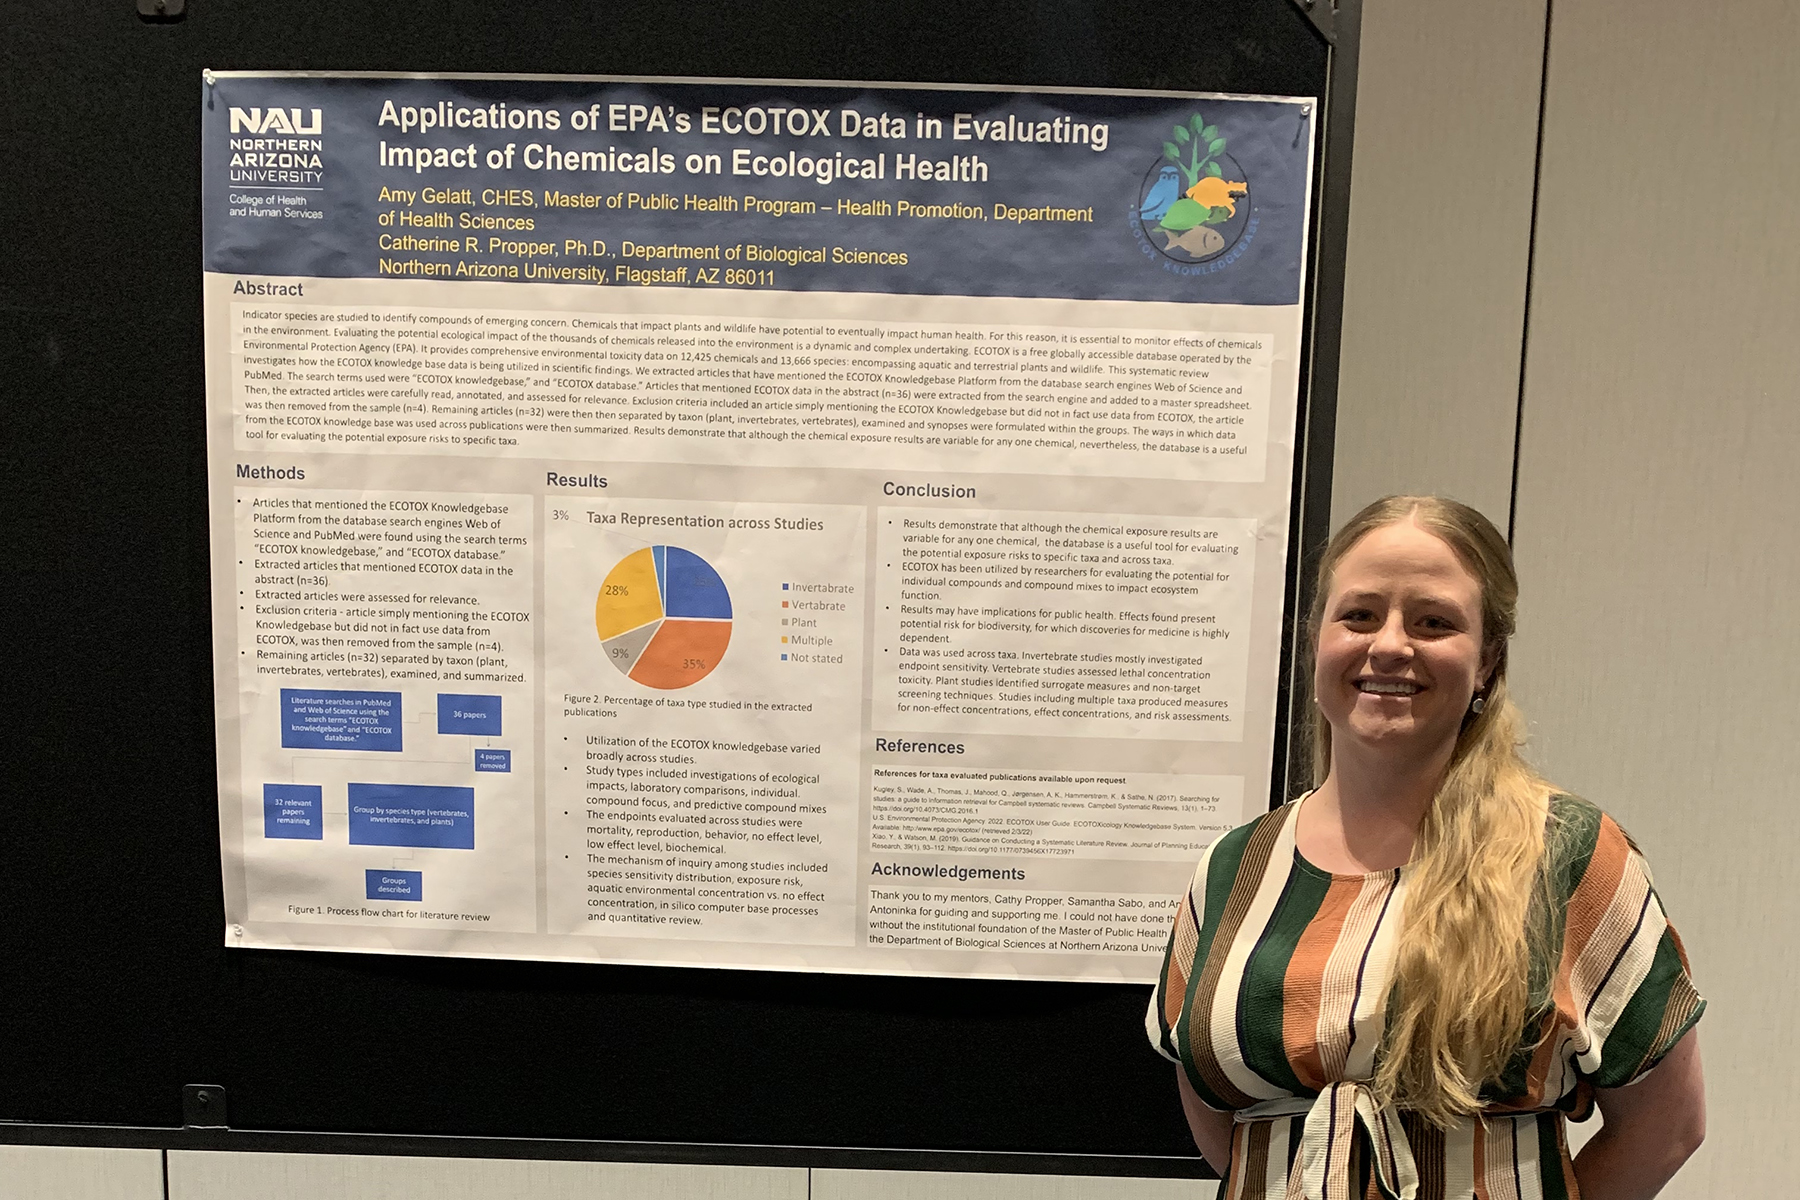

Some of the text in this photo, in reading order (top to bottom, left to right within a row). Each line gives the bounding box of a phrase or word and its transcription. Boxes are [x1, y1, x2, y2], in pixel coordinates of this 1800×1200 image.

[228, 106, 322, 135] NAU
[378, 99, 1108, 151] Applications of EPA's ECOTOX Data in Evaluating
[229, 138, 322, 151] NORTHERN
[229, 152, 322, 168] ARIZONA
[380, 140, 988, 183] Impact of Chemicals on Ecological Health
[230, 169, 322, 183] UNIVERSITY
[229, 193, 306, 208] College of Health
[378, 186, 416, 206] Amy
[421, 187, 475, 207] Gelatt,
[481, 188, 538, 208] CHES,
[544, 190, 602, 208] Master
[606, 192, 623, 208] of
[628, 192, 678, 210] Public
[684, 193, 738, 211] Health
[744, 195, 815, 217] Program
[837, 198, 891, 216] Health
[897, 200, 987, 222] Promotion,
[994, 203, 1093, 224] Department
[229, 206, 323, 219] and Human Services
[378, 209, 534, 230] of Health Sciences
[379, 233, 908, 266] Catherine R. Propper, Ph.D., Department of Biological Sciences
[1128, 210, 1260, 276] ECOTOX KNOWLEDGEBASE
[379, 258, 774, 286] Northern Arizona University, Flagstaff, AZ 86011
[233, 279, 303, 296] Abstract
[246, 430, 263, 439] tool
[266, 430, 278, 440] for
[280, 431, 326, 442] evaluating
[328, 431, 342, 441] the
[345, 432, 384, 443] potential
[386, 434, 426, 444] exposure
[428, 434, 448, 444] risks
[451, 435, 460, 444] to
[462, 435, 496, 446] specific
[236, 463, 305, 480] Methods
[546, 471, 607, 488] Results
[883, 481, 975, 498] Conclusion
[252, 497, 508, 516] Articles that mentioned the ECOTOX Knowledgebase
[552, 509, 569, 520] 3%
[586, 510, 823, 530] Taxa Representation across Studies
[605, 584, 628, 596] 28%
[792, 582, 854, 594] Invertabrate
[901, 575, 1198, 596] individual compounds and compound mixes to impact ecosystem
[255, 589, 479, 605] Extracted articles were assessed for relevance.
[792, 600, 845, 611] Vertabrate
[791, 616, 816, 628] Plant
[791, 634, 832, 647] Multiple
[612, 648, 629, 658] 9%
[790, 652, 843, 664] Not stated
[682, 659, 705, 670] 35%
[453, 710, 462, 718] 36
[586, 735, 820, 754] Utilization of the ECOTOX knowledgebase varied
[876, 737, 964, 754] References
[586, 750, 696, 764] broadly across studies.
[479, 762, 506, 770] removed
[874, 768, 917, 778] References
[919, 770, 930, 778] for
[950, 772, 987, 780] evaluated
[989, 773, 1036, 782] publications
[1038, 775, 1072, 783] available
[274, 798, 312, 806] 32 relevant
[276, 817, 310, 826] remaining
[871, 862, 1025, 882] Acknowledgements
[377, 885, 410, 893] described
[380, 876, 406, 887] Groups
[287, 904, 314, 915] Figure
[326, 905, 359, 916] Process
[360, 907, 379, 917] flow
[382, 908, 404, 917] chart
[405, 909, 417, 918] for
[419, 910, 458, 920] literature
[461, 913, 490, 921] review
[869, 920, 1167, 938] without the institutional foundation of the Master of Public Health
